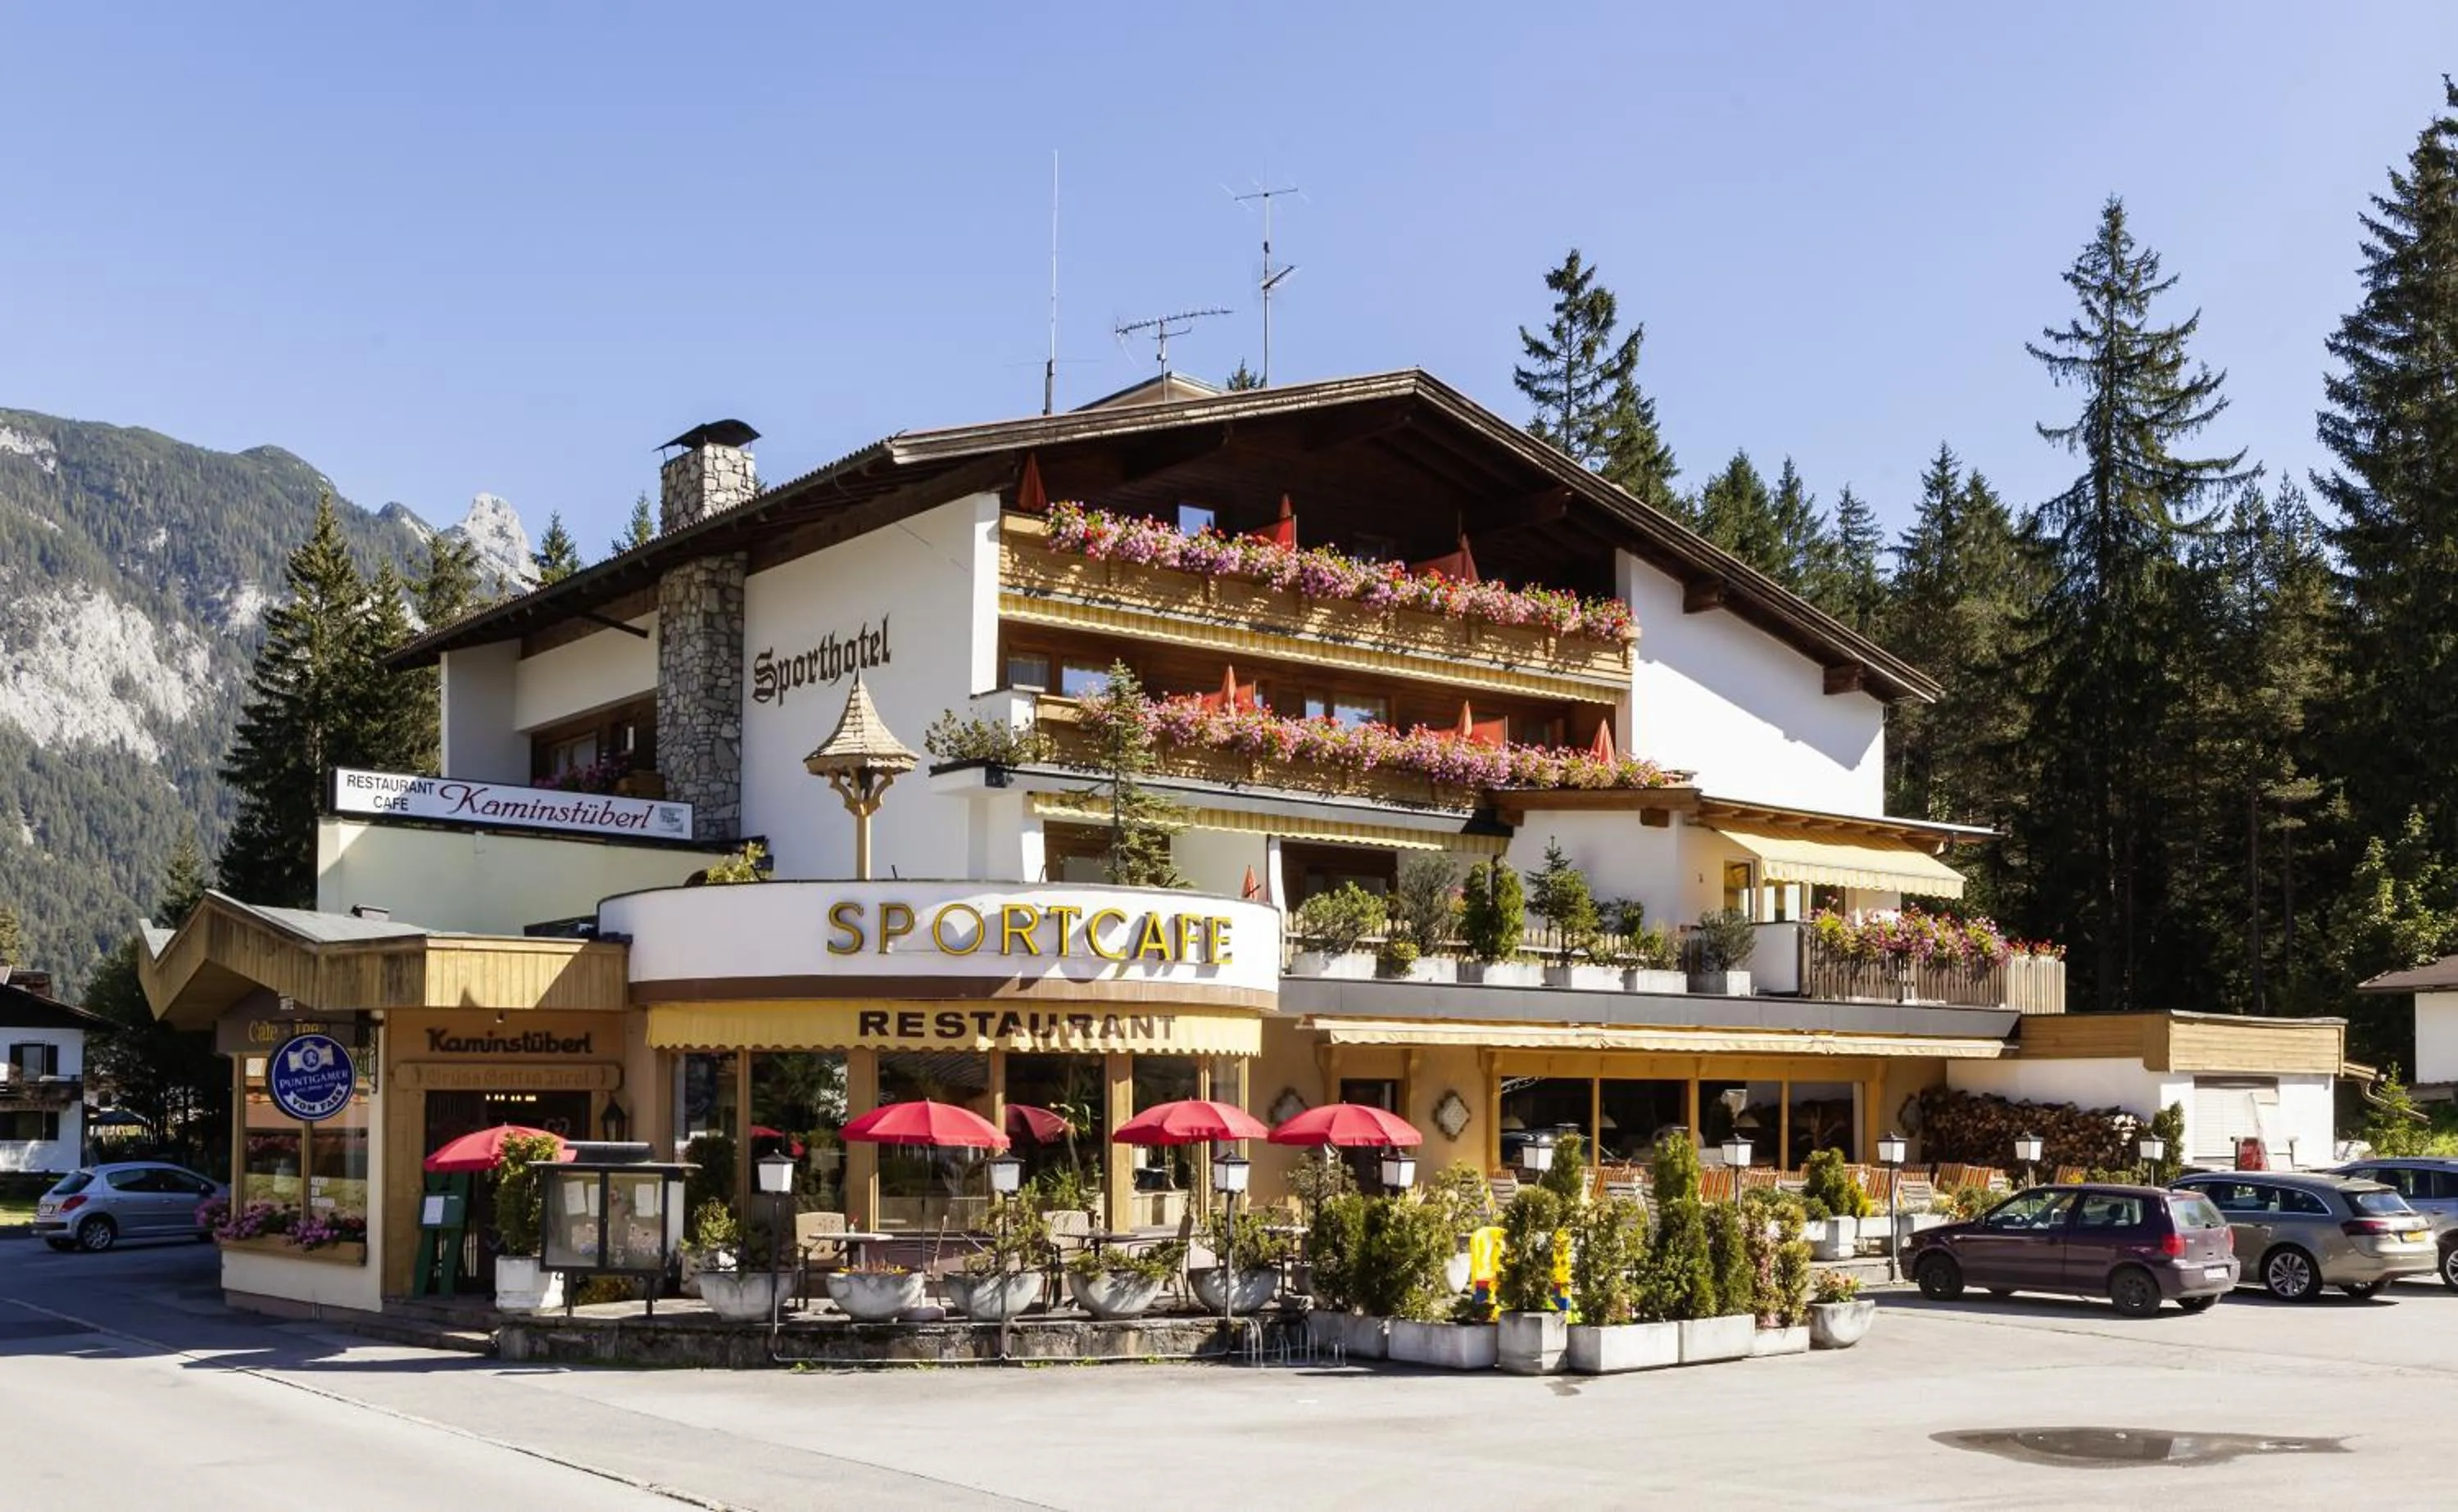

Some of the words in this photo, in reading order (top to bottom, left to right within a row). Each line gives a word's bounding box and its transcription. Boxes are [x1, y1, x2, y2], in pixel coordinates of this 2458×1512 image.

[752, 612, 892, 708] Sporthotel
[347, 774, 435, 795] RESTAURANT
[373, 795, 409, 811] CAFE
[439, 784, 655, 830] Kaminstüberl
[827, 902, 1232, 965] SPORTCAFE
[859, 1011, 1176, 1040] RESTAURANT
[425, 1027, 593, 1054] Kaminstüberl
[293, 1097, 316, 1111] VOM
